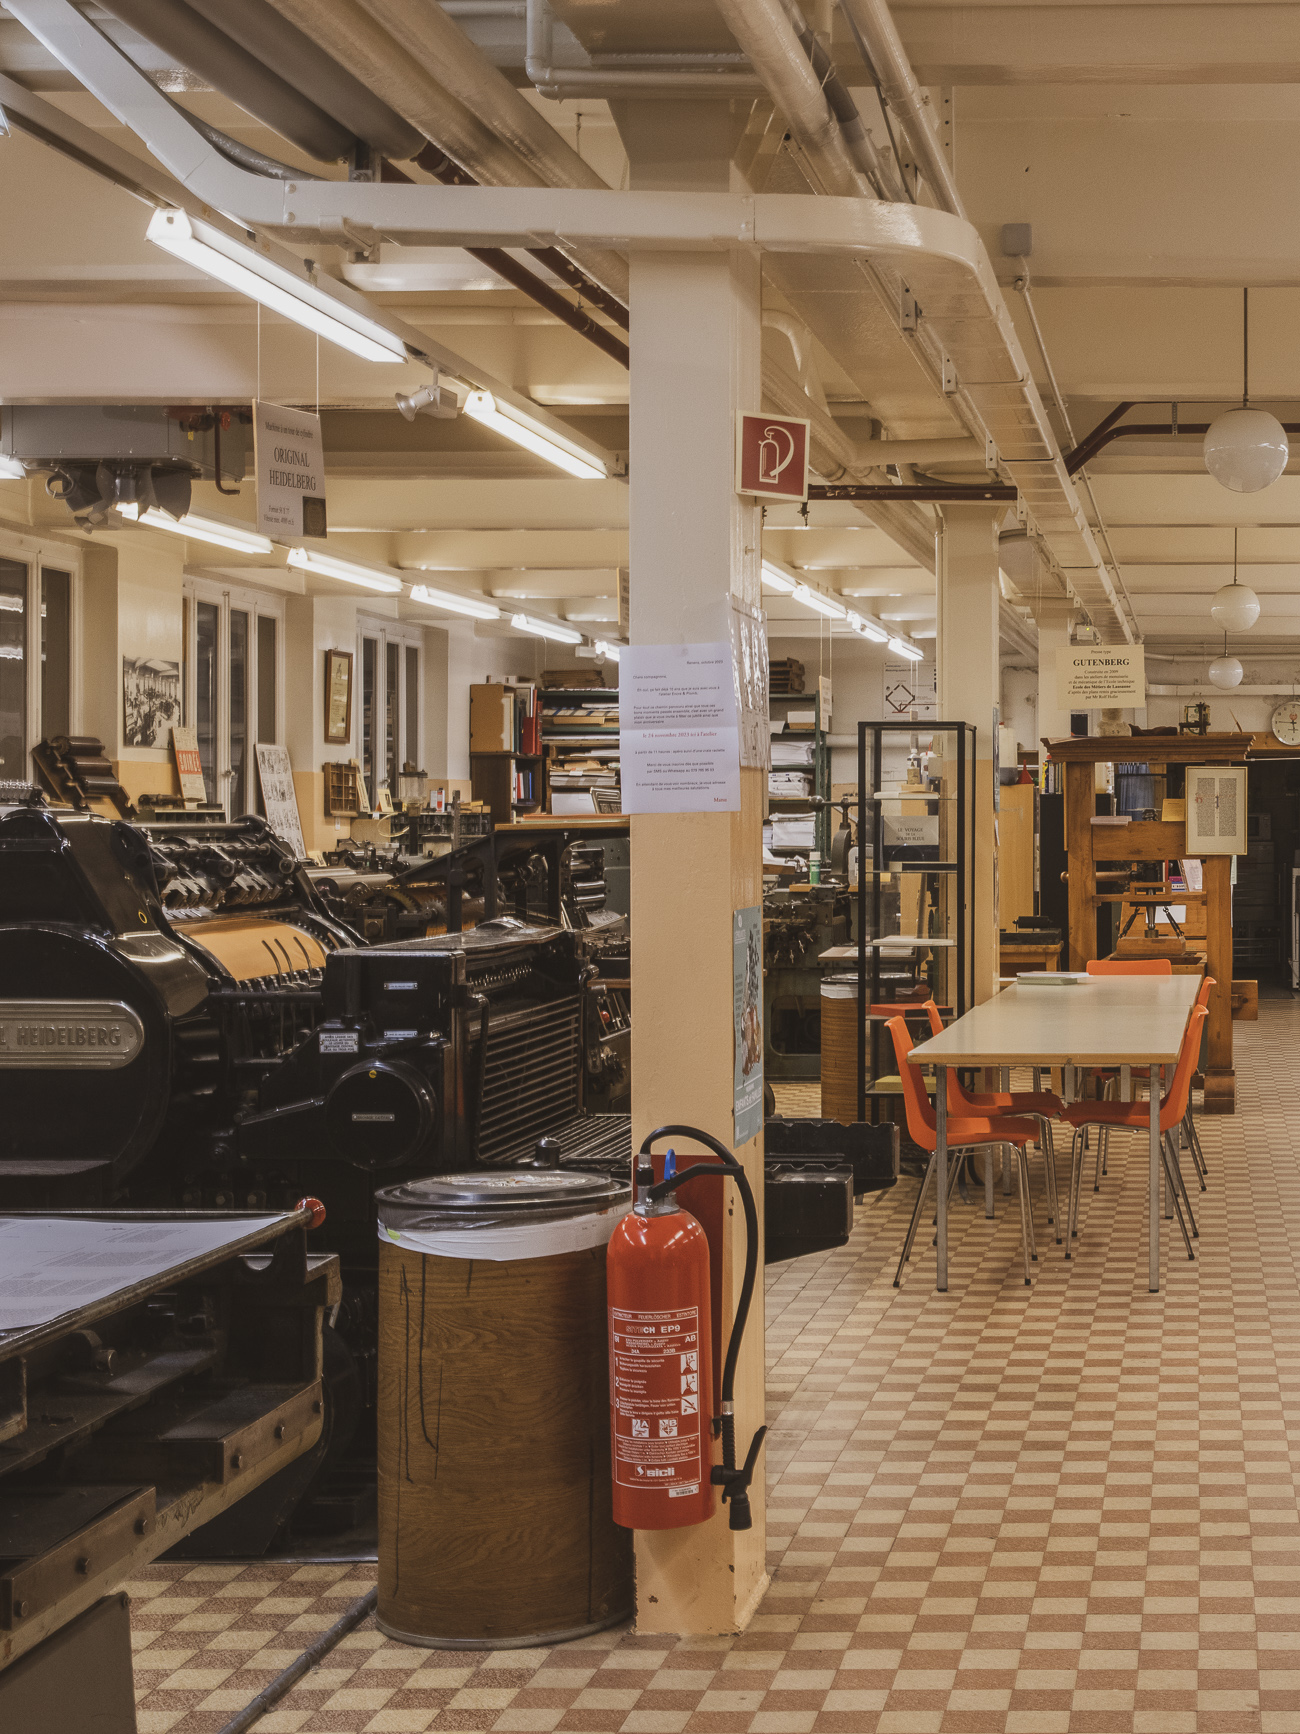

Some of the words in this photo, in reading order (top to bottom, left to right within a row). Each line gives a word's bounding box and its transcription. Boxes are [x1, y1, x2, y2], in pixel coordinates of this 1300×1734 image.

[274, 446, 310, 468] ORIGINAL
[269, 469, 316, 491] HEIDELBERG
[17, 1025, 121, 1046] HEIDELBERG
[661, 1325, 680, 1333] EP9
[616, 1357, 619, 1366] 1
[616, 1376, 619, 1387] 2
[616, 1398, 619, 1408] 3
[647, 1467, 675, 1477] sicli
